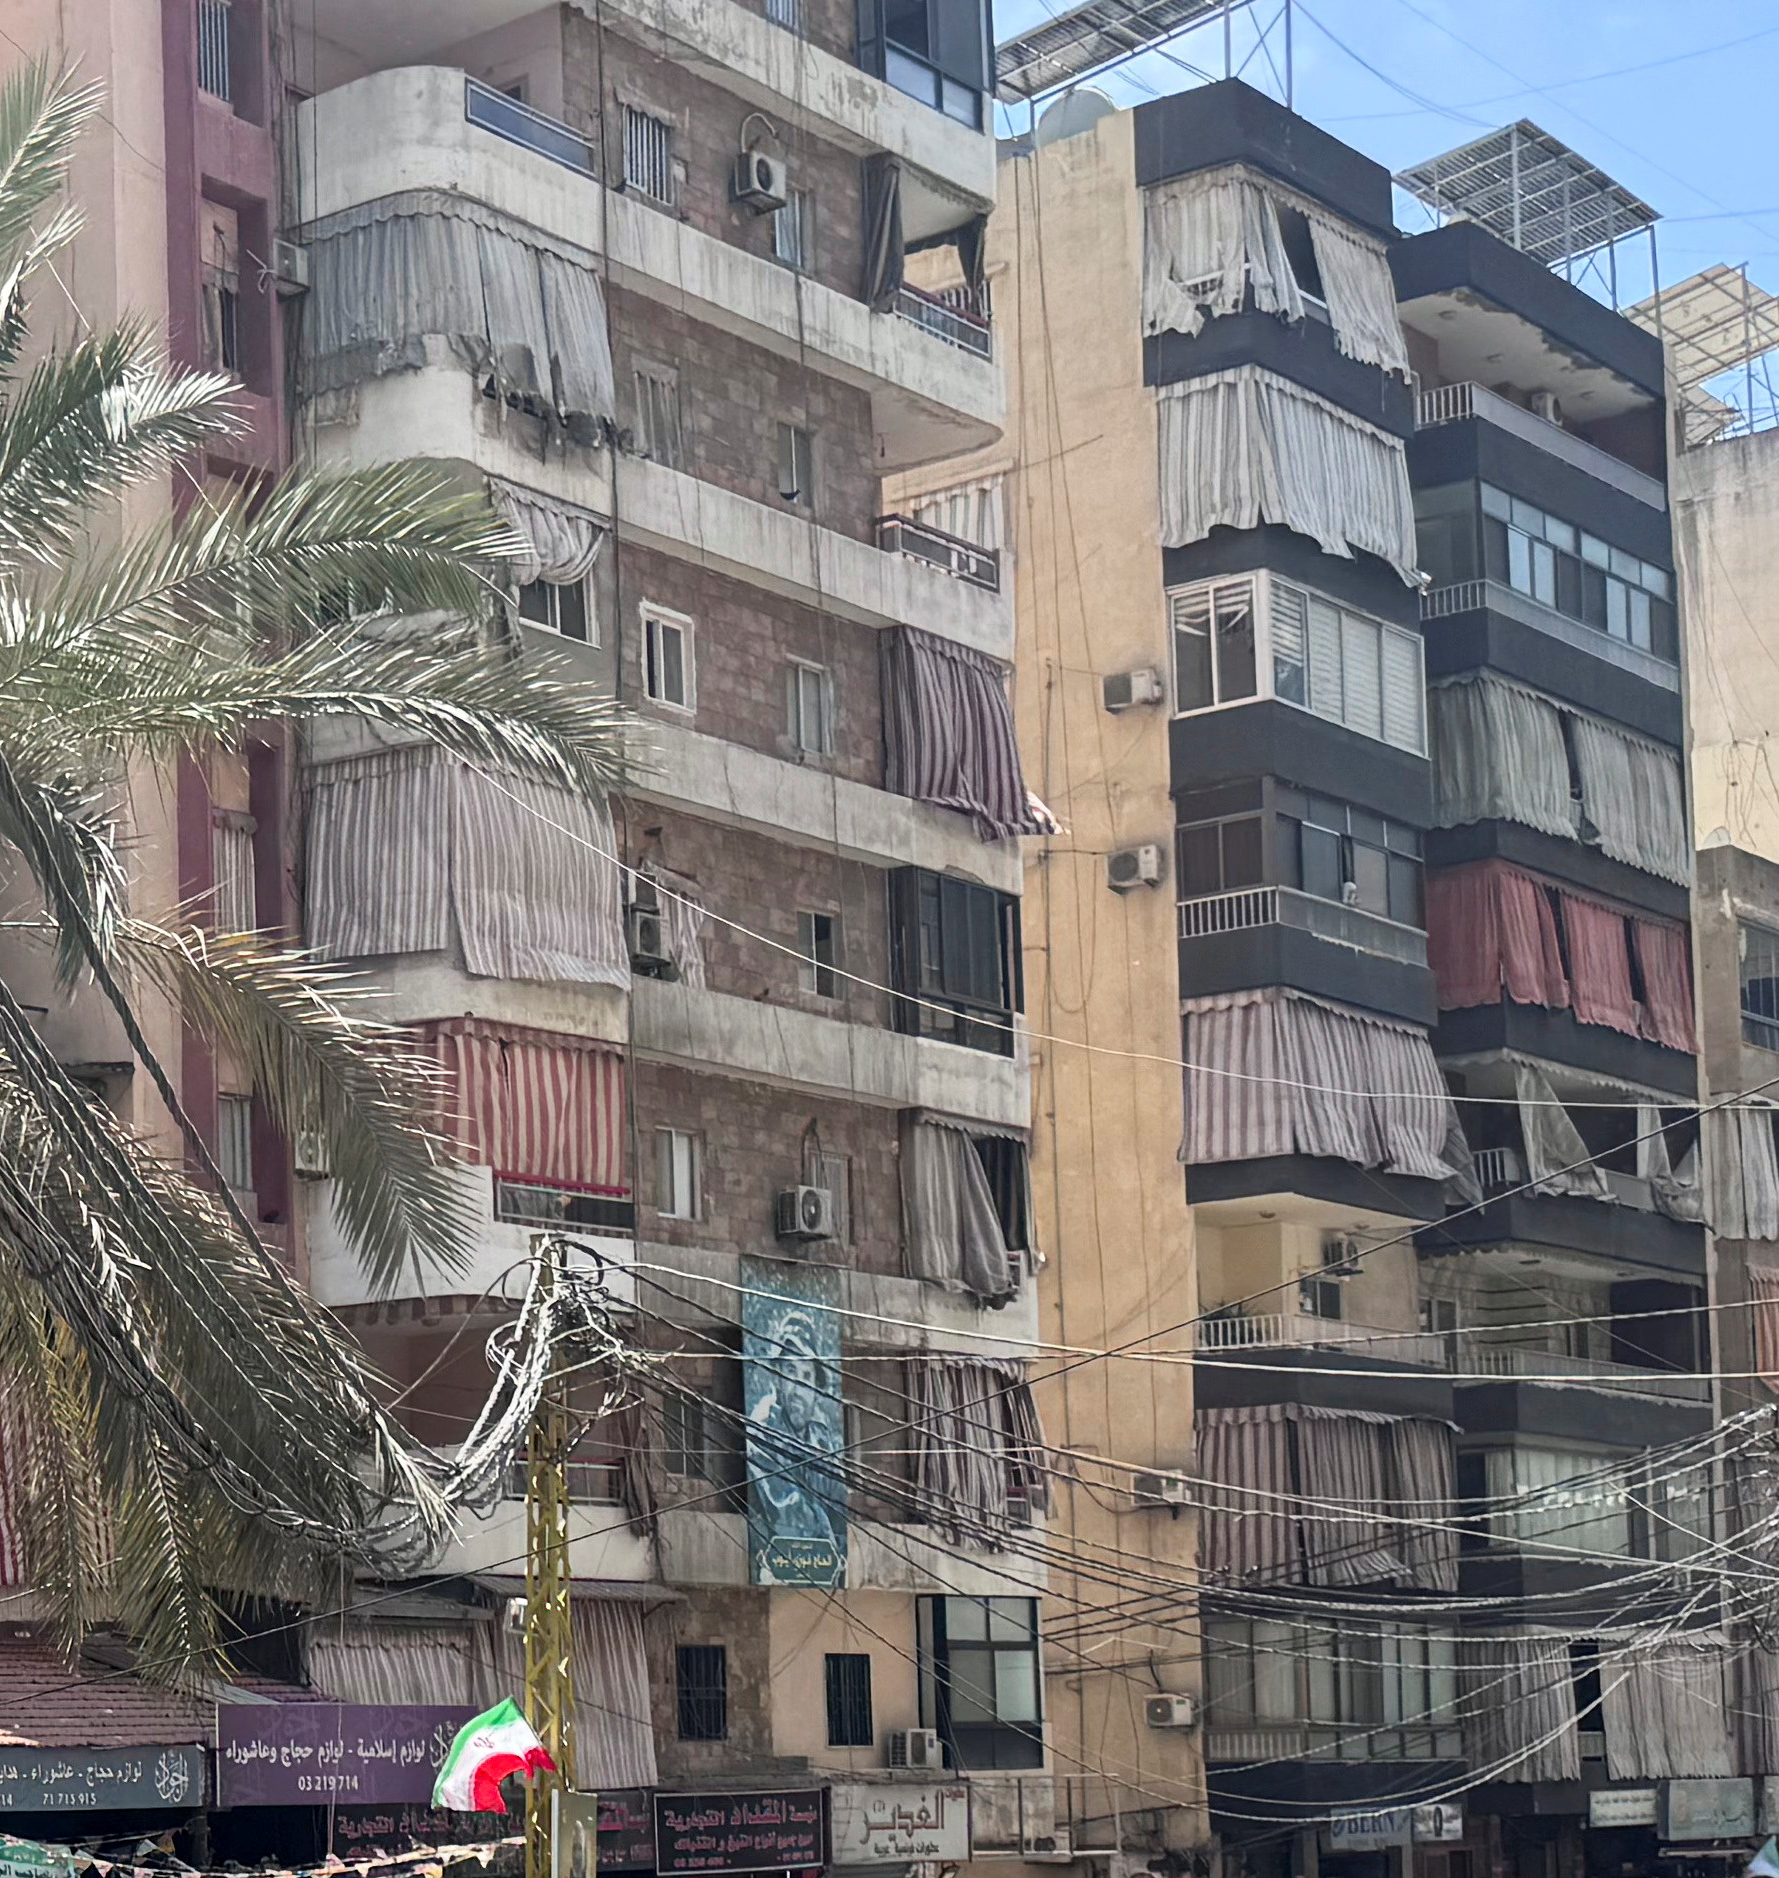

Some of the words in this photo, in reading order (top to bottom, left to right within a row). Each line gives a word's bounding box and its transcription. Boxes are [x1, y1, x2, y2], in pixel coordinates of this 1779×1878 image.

[226, 1740, 277, 1765] وعاشوراء
[281, 1740, 314, 1768] حجاج
[318, 1740, 344, 1768] لوازم
[356, 1738, 397, 1764] إسلامية
[400, 1739, 426, 1767] لوازم
[298, 1776, 312, 1791] 03
[314, 1775, 335, 1791] 219
[337, 1775, 359, 1791] 714
[859, 1789, 944, 1845] الغدير
